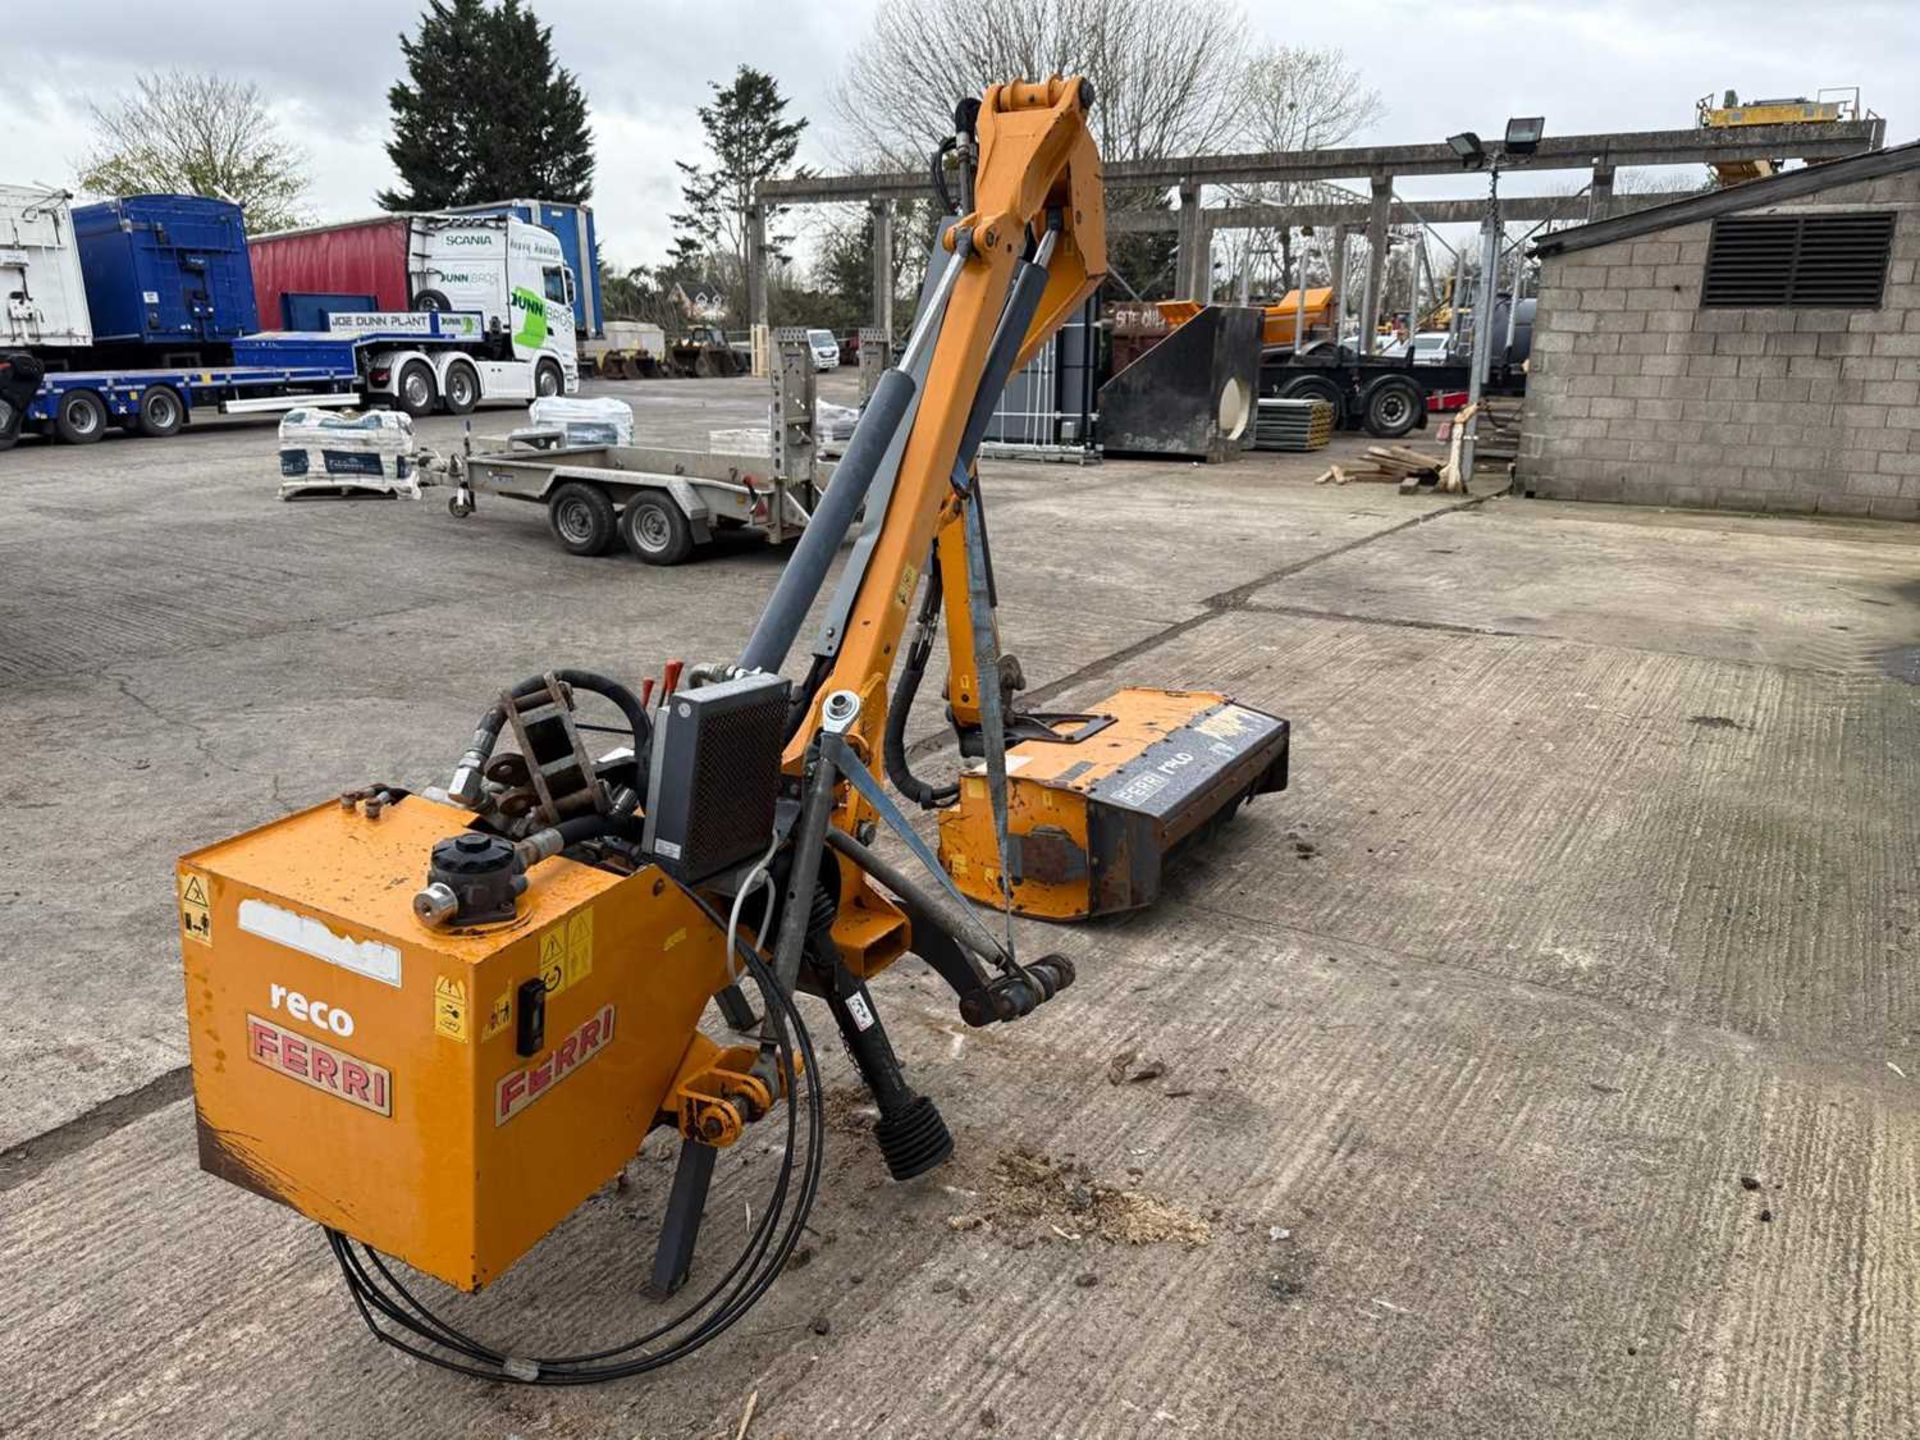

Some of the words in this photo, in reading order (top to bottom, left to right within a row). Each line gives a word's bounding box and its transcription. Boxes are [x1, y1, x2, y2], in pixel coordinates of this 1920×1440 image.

[446, 235, 492, 246] SCANIA
[331, 316, 353, 327] JOE
[356, 316, 387, 327] DUNN
[391, 316, 428, 326] PLANT
[511, 292, 544, 316] DUNN
[546, 306, 574, 329] BROS
[1117, 772, 1166, 801] FERRI
[270, 982, 354, 1038] reco
[252, 1022, 386, 1108] FERRI
[501, 1006, 613, 1116] FERRI
